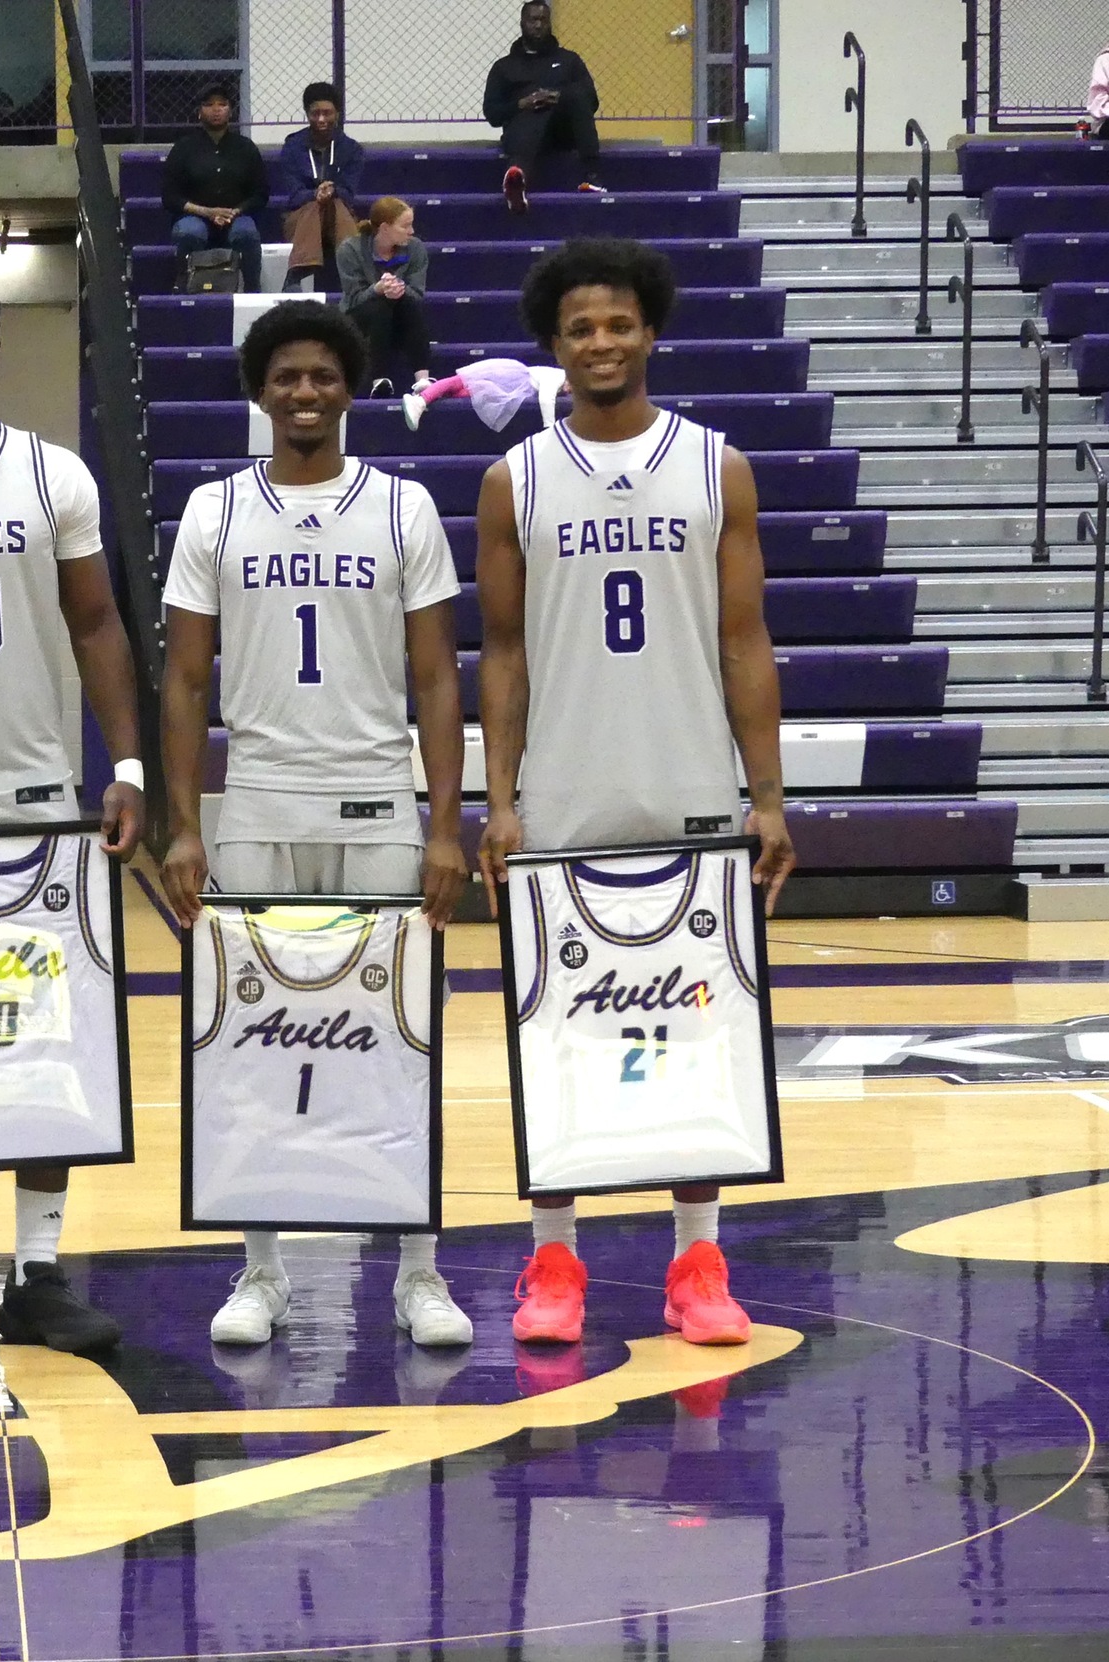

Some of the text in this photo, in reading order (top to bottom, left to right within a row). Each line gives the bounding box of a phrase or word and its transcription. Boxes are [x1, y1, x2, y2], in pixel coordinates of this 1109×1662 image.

[557, 516, 687, 558] EAGLES
[242, 553, 376, 589] EAGLES
[603, 569, 646, 654] 8
[295, 603, 322, 684] 1
[47, 888, 66, 903] DC
[557, 931, 583, 940] adidas
[693, 914, 713, 929] DC
[564, 944, 584, 961] JB
[242, 981, 259, 996] JB
[365, 968, 385, 984] DC
[567, 965, 715, 1019] Avila
[233, 1006, 378, 1053] Avila
[620, 1024, 668, 1082] 21
[296, 1063, 313, 1115] 1
